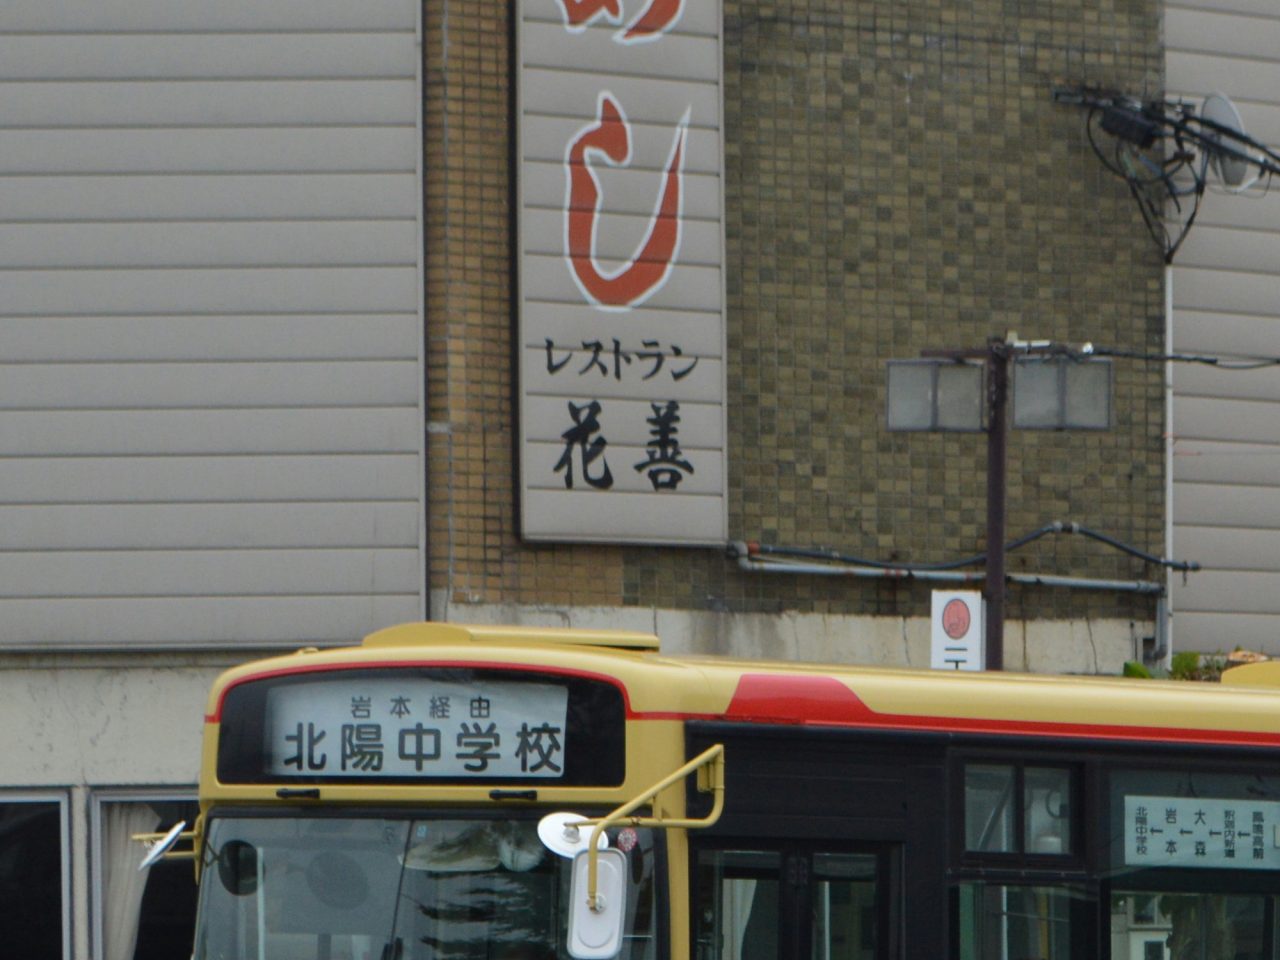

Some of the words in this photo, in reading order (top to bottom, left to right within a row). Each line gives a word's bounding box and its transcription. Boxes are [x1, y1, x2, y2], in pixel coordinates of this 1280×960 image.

[545, 337, 698, 382] レストラン
[553, 400, 694, 491] 花善
[351, 695, 491, 719] 岩本経由
[284, 722, 562, 773] 北陽中学校
